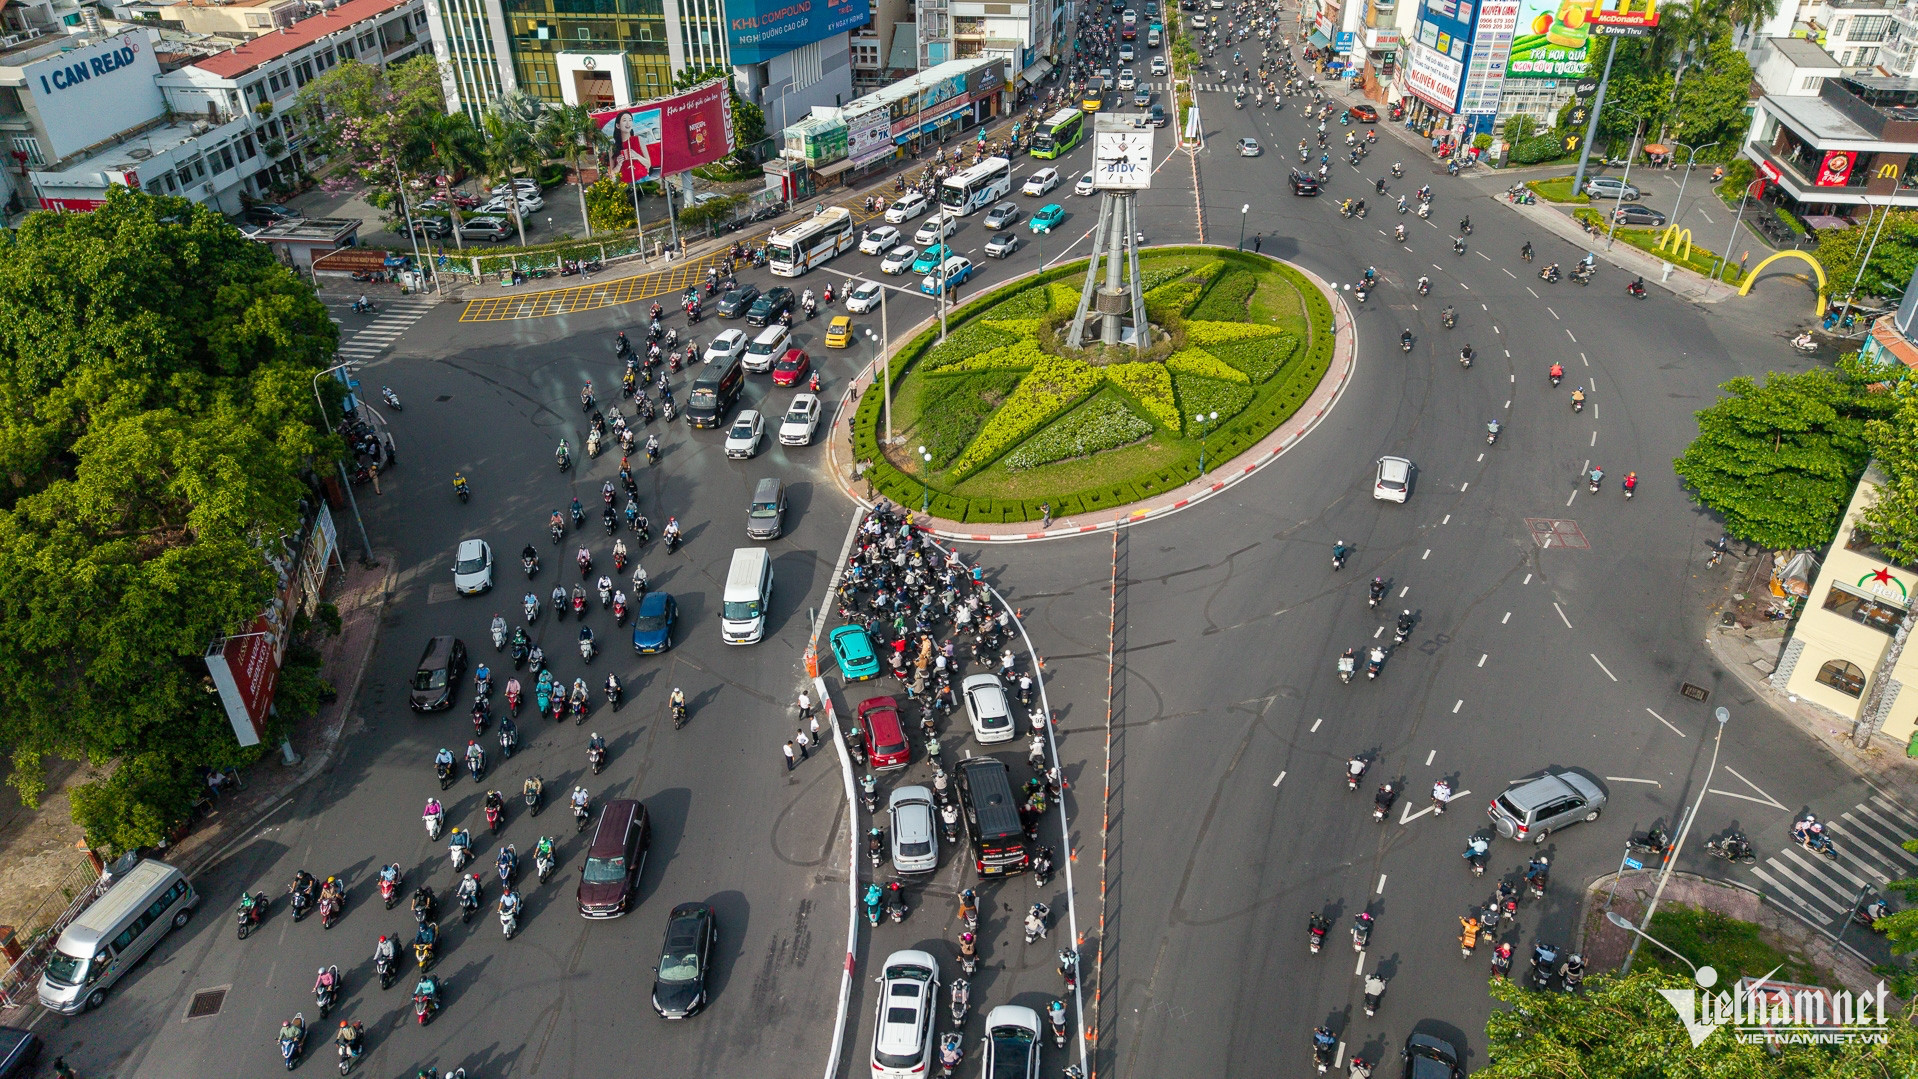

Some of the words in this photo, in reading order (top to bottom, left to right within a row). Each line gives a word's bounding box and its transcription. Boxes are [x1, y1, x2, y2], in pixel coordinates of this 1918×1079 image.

[732, 17, 760, 31] KHU
[762, 0, 811, 25] COMPOUND
[1502, 6, 1518, 16] GIANG
[835, 18, 849, 29] NGAY
[1598, 15, 1644, 24] McDonald's
[783, 23, 796, 33] CAO
[1605, 26, 1625, 34] Drive
[1627, 27, 1643, 35] Thru
[1548, 51, 1565, 60] HOA
[1568, 47, 1587, 60] QUẢ
[40, 75, 51, 94] I
[52, 61, 91, 90] CAN
[90, 46, 135, 77] READ
[1513, 62, 1532, 71] NGON
[1436, 82, 1456, 101] GIANG
[878, 129, 889, 141] 7K
[1107, 164, 1136, 173] BIDV
[246, 636, 260, 678] BRANDED
[250, 644, 267, 695] RESIDENCES
